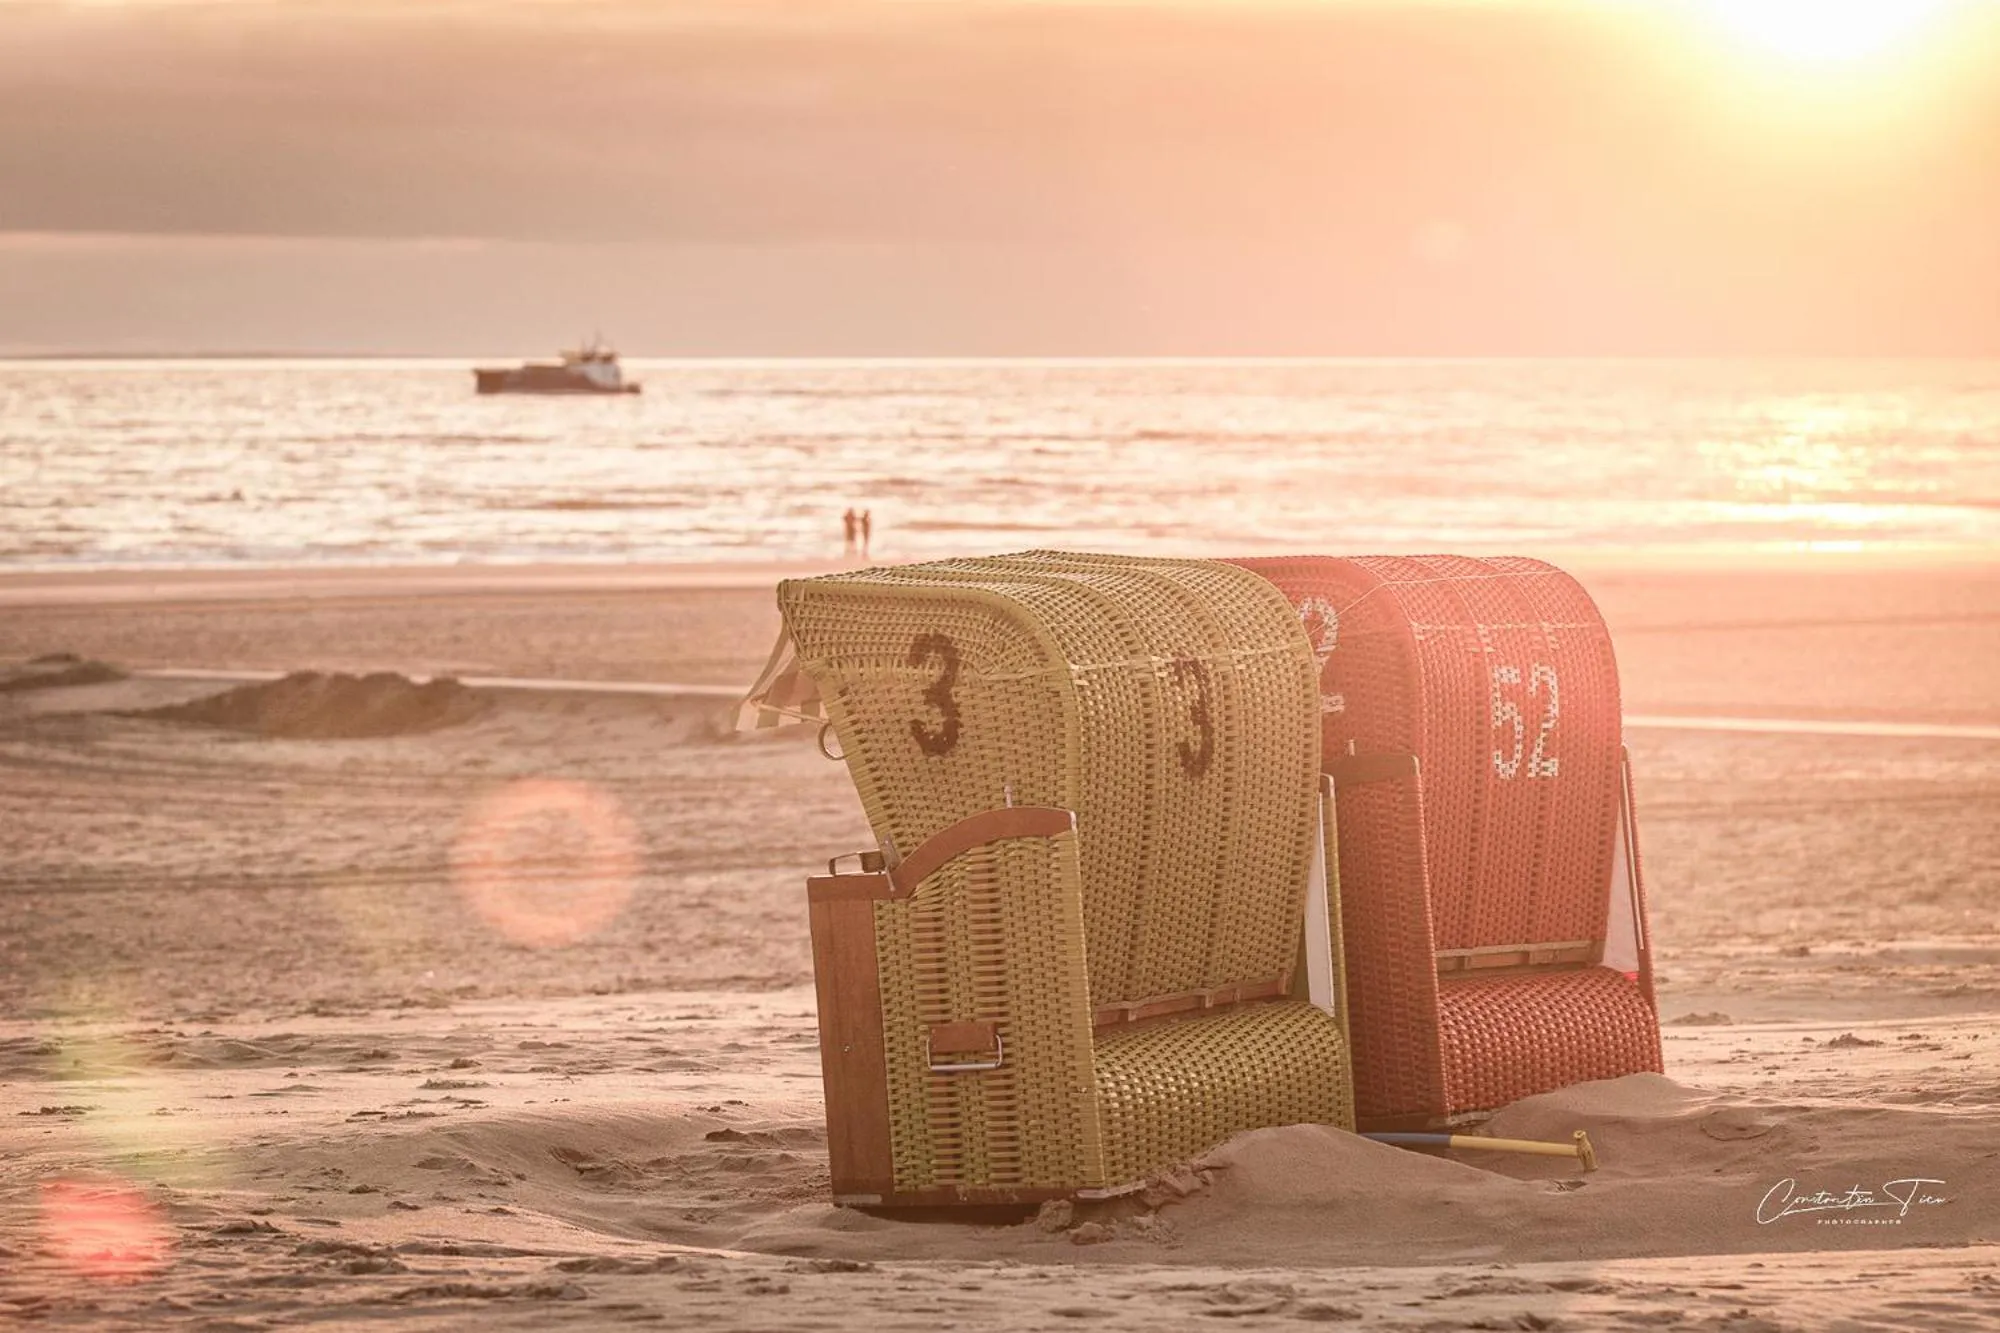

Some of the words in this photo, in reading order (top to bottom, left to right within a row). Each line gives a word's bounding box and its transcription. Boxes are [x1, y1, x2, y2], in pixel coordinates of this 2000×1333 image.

[906, 632, 963, 755] 3
[1173, 656, 1215, 778] 3
[1492, 662, 1559, 779] 52
